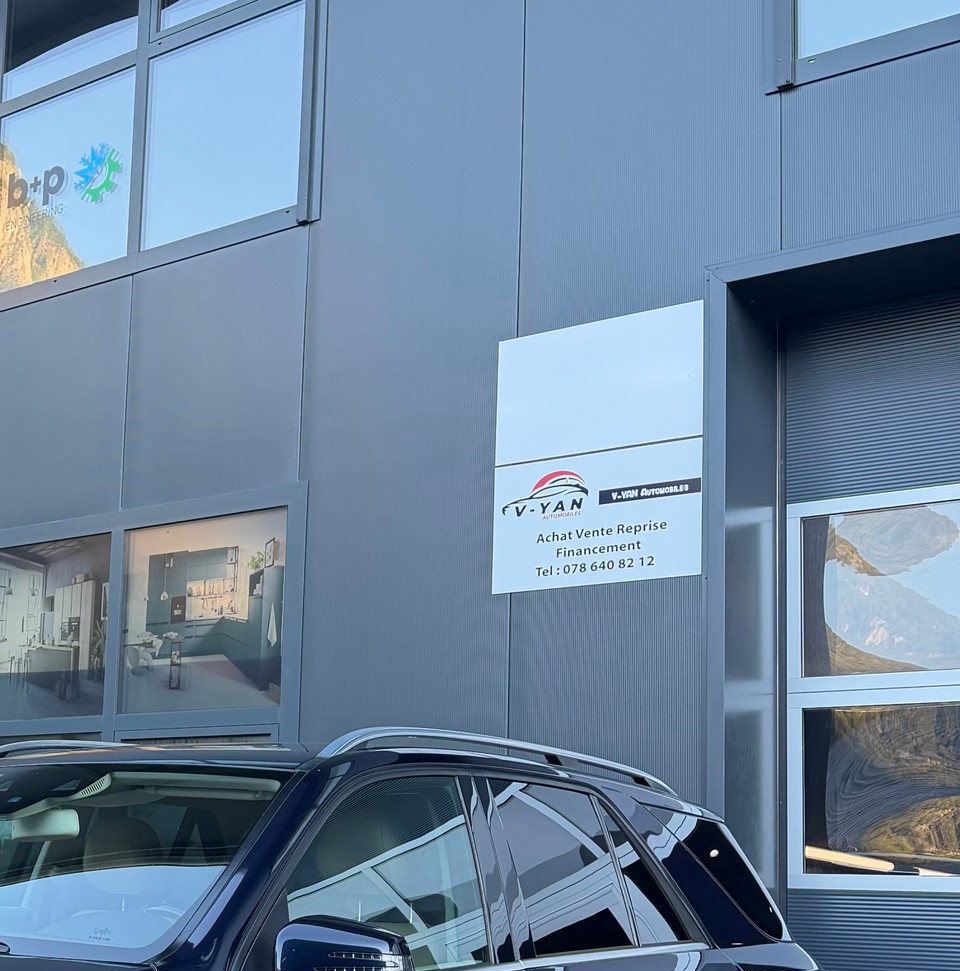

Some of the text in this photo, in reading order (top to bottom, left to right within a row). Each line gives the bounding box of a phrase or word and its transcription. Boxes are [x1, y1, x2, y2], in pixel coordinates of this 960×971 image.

[7, 165, 65, 208] b+p
[611, 489, 639, 501] V-YAN
[515, 498, 583, 517] V-YAN
[543, 511, 581, 519] AUTOMOBILES
[536, 520, 667, 544] Achat Vente Reprise
[556, 540, 641, 558] Financement
[563, 562, 587, 574] 078
[590, 560, 615, 572] 640
[618, 558, 634, 569] 82
[639, 555, 655, 567] 12
